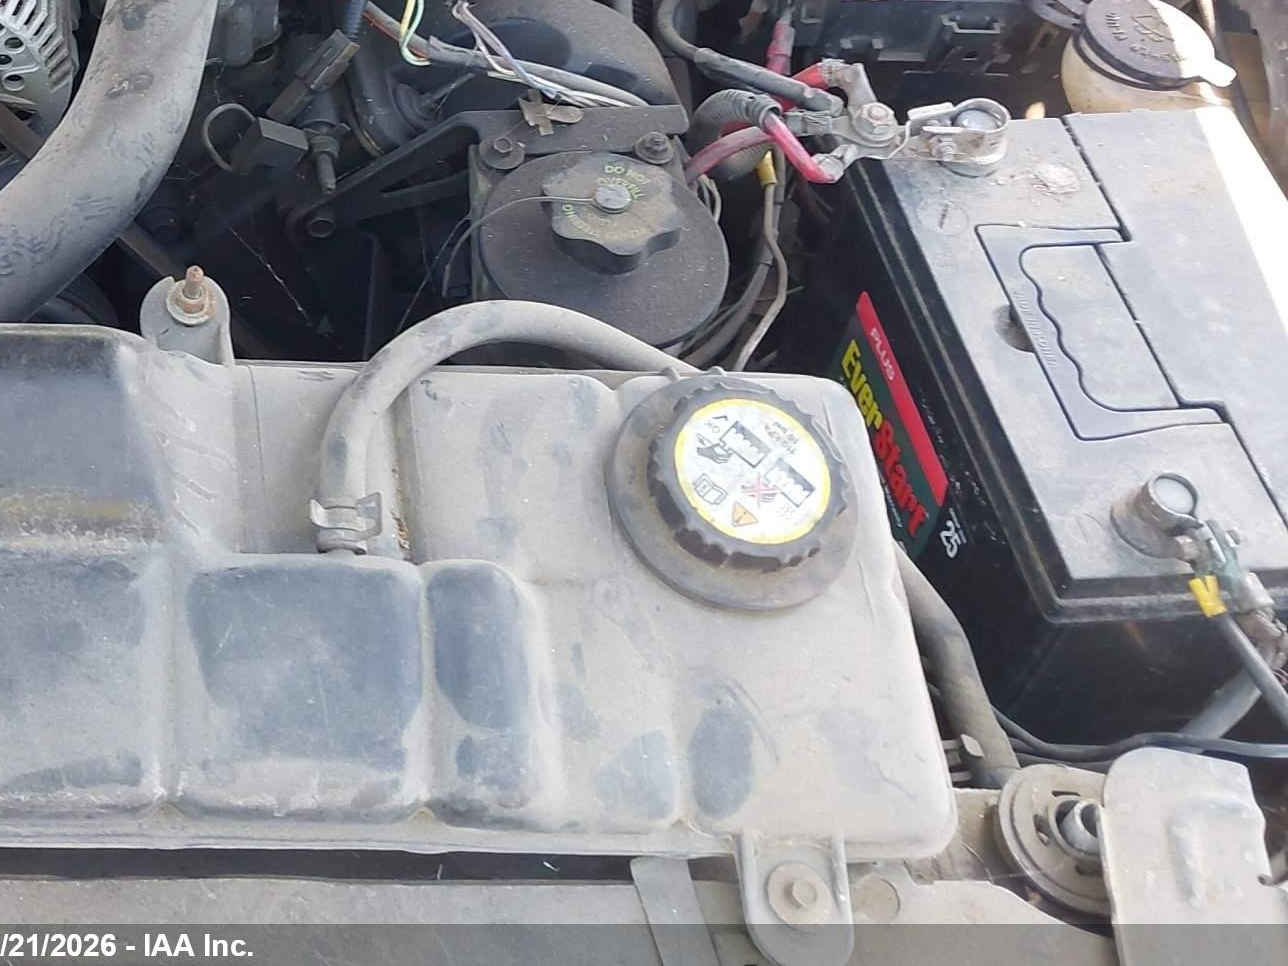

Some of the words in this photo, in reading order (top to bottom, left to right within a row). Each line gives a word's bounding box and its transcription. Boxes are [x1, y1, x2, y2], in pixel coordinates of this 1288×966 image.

[604, 165, 625, 174] DO
[868, 326, 898, 382] PLUS
[840, 339, 931, 538] EverStart
[939, 520, 961, 559] 25
